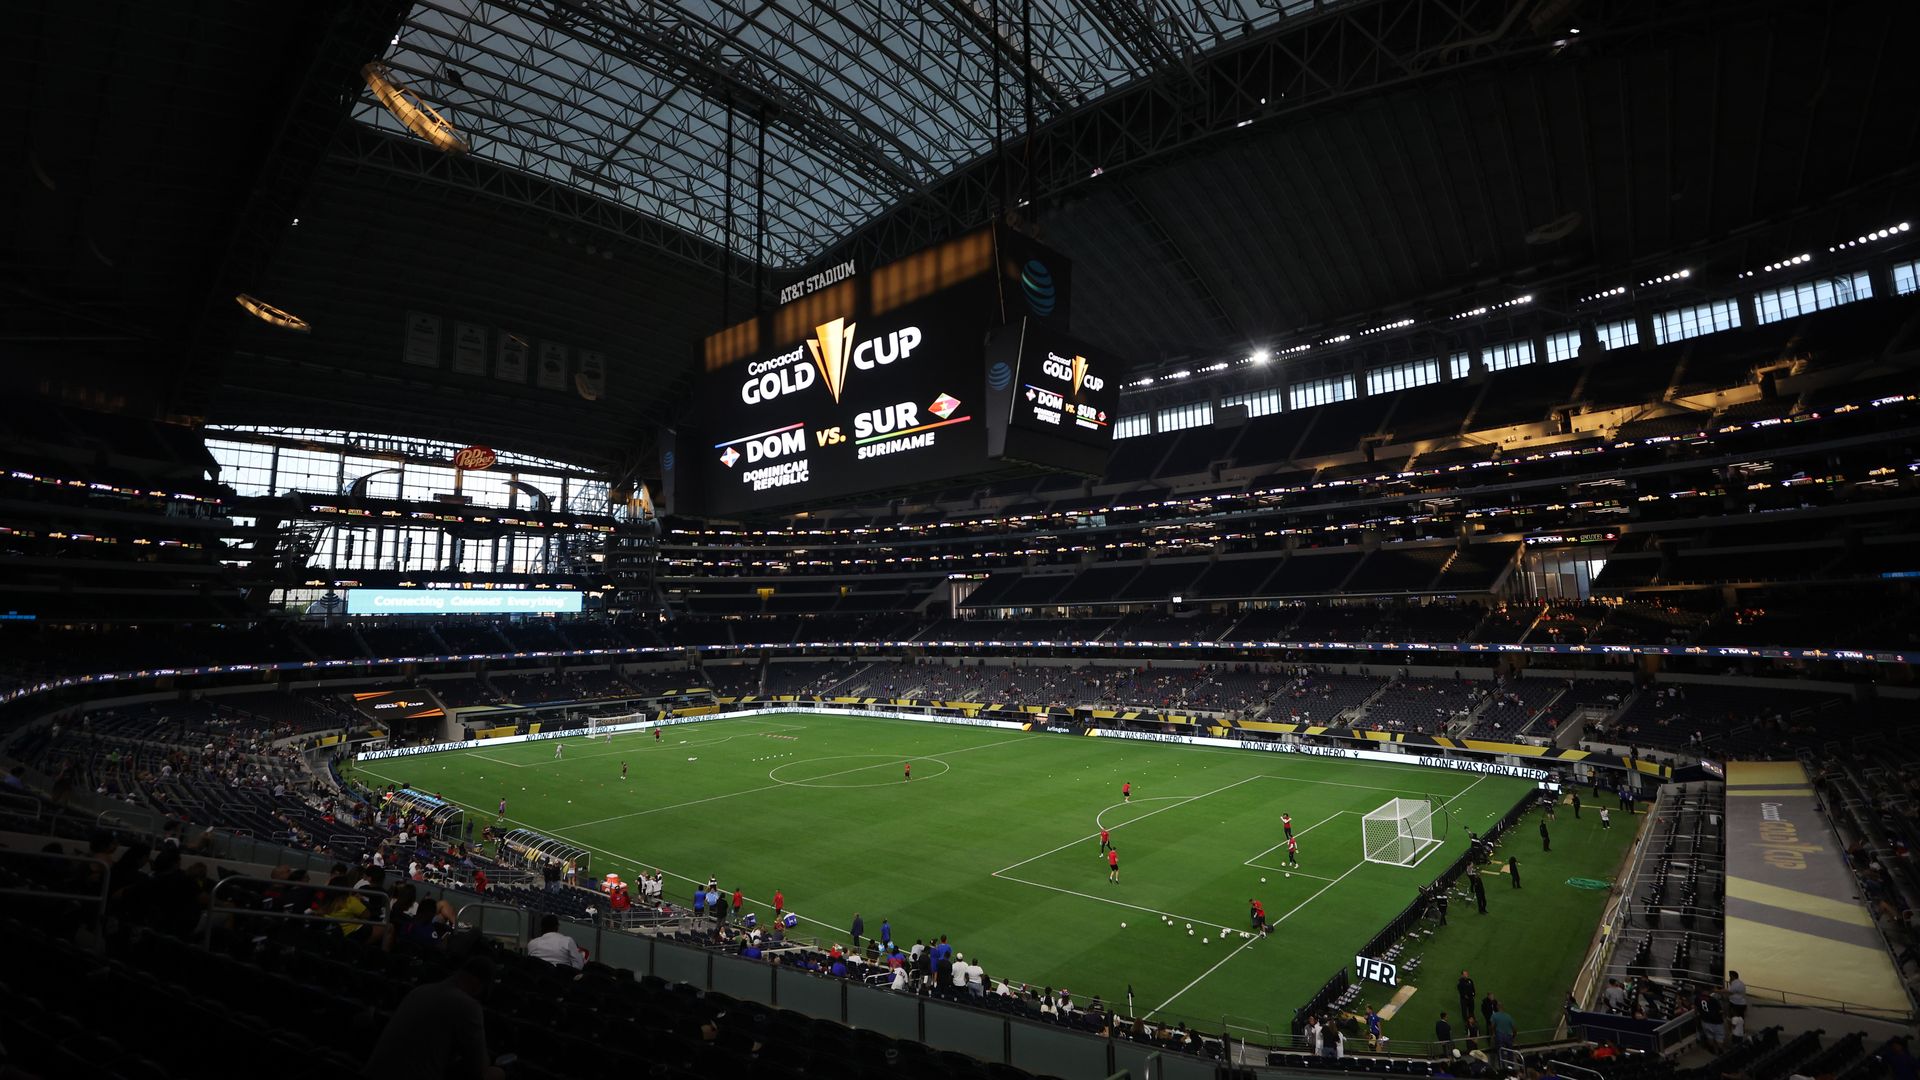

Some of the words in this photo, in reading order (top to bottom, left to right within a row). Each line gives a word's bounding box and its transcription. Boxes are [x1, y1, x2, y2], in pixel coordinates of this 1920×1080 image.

[780, 281, 805, 305] AT&T
[806, 259, 856, 294] STADIUM
[742, 362, 816, 404] GOLD
[853, 326, 922, 370] CUP
[748, 345, 804, 376] Concacaf
[1043, 360, 1073, 382] GOLD
[1083, 374, 1104, 392] CUP
[1038, 391, 1064, 410] DOM
[1077, 403, 1097, 420] SUR
[746, 428, 806, 463] DOM
[853, 401, 920, 438] SUR
[472, 449, 487, 459] Dr
[857, 431, 935, 460] SURINAME
[459, 450, 494, 468] Pepper
[743, 459, 808, 483] DOMINICAN
[753, 470, 809, 491] REPUBLIC
[373, 596, 445, 609] Connecting
[1047, 726, 1070, 734] Arlington
[1100, 729, 1108, 737] NO
[1108, 730, 1123, 738] ONE
[1124, 731, 1138, 739] WAS
[1140, 732, 1158, 741] BORN
[364, 751, 378, 760] NO
[379, 750, 396, 759] ONE
[398, 747, 416, 756] WAS
[417, 745, 438, 754] BORN
[1241, 741, 1252, 749] NO
[1252, 742, 1269, 750] ONE
[1271, 743, 1288, 752] WAS
[1420, 757, 1433, 766] NO
[1434, 758, 1454, 769] ONE
[1456, 760, 1479, 772] WAS
[1481, 762, 1510, 776] BORN
[1512, 766, 1519, 777] A
